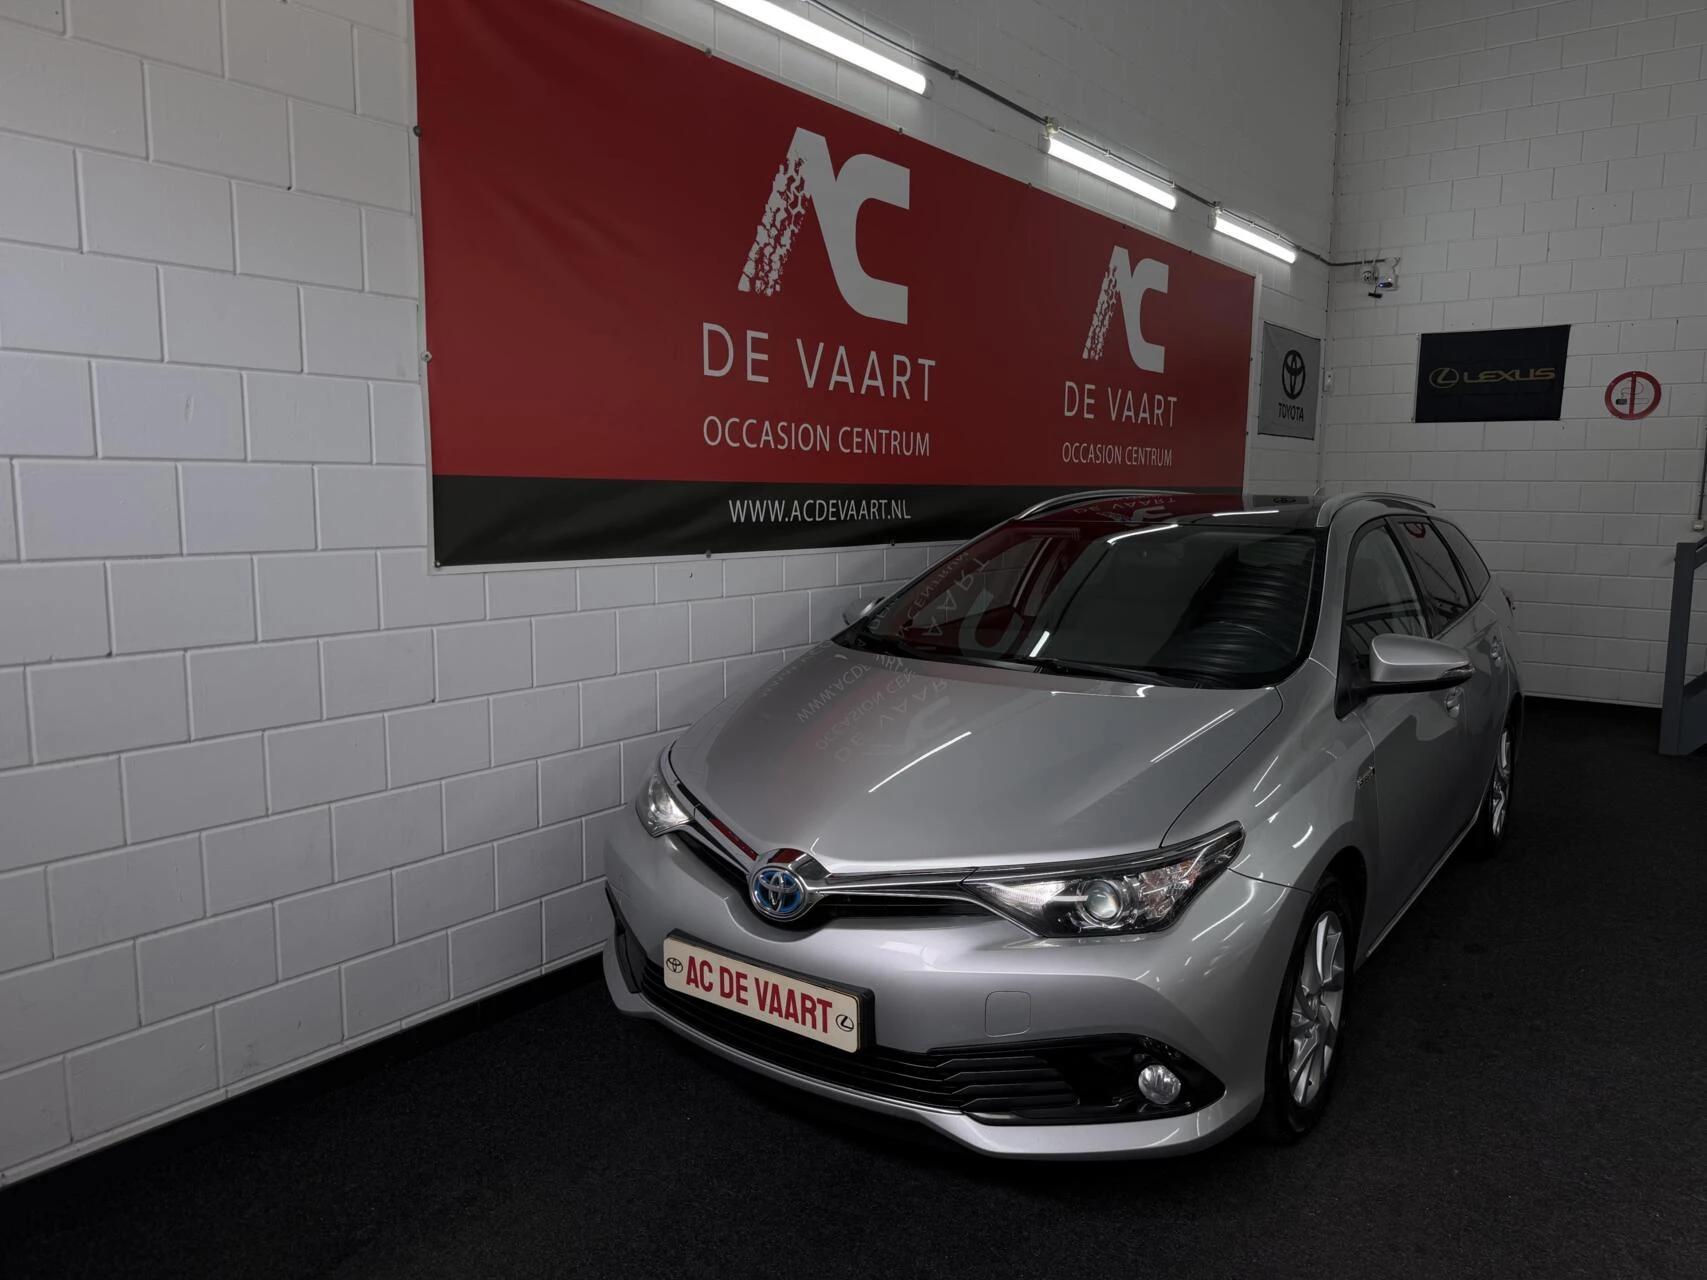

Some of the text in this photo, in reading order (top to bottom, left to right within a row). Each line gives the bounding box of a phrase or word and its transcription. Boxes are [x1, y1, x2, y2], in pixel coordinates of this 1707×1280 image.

[738, 127, 910, 325] AC
[1082, 245, 1169, 374] AC
[702, 322, 936, 402] DE VAART
[1463, 367, 1556, 384] LEXUS
[1064, 381, 1178, 428] DE VAART
[1278, 402, 1304, 423] TOYOTA
[703, 415, 931, 457] OCCASION CENTRUM
[1062, 441, 1172, 467] OCCASION CENTRUM
[728, 499, 912, 523] WWW.ACDEVAART.NL
[686, 955, 833, 1034] AC DE VAART
